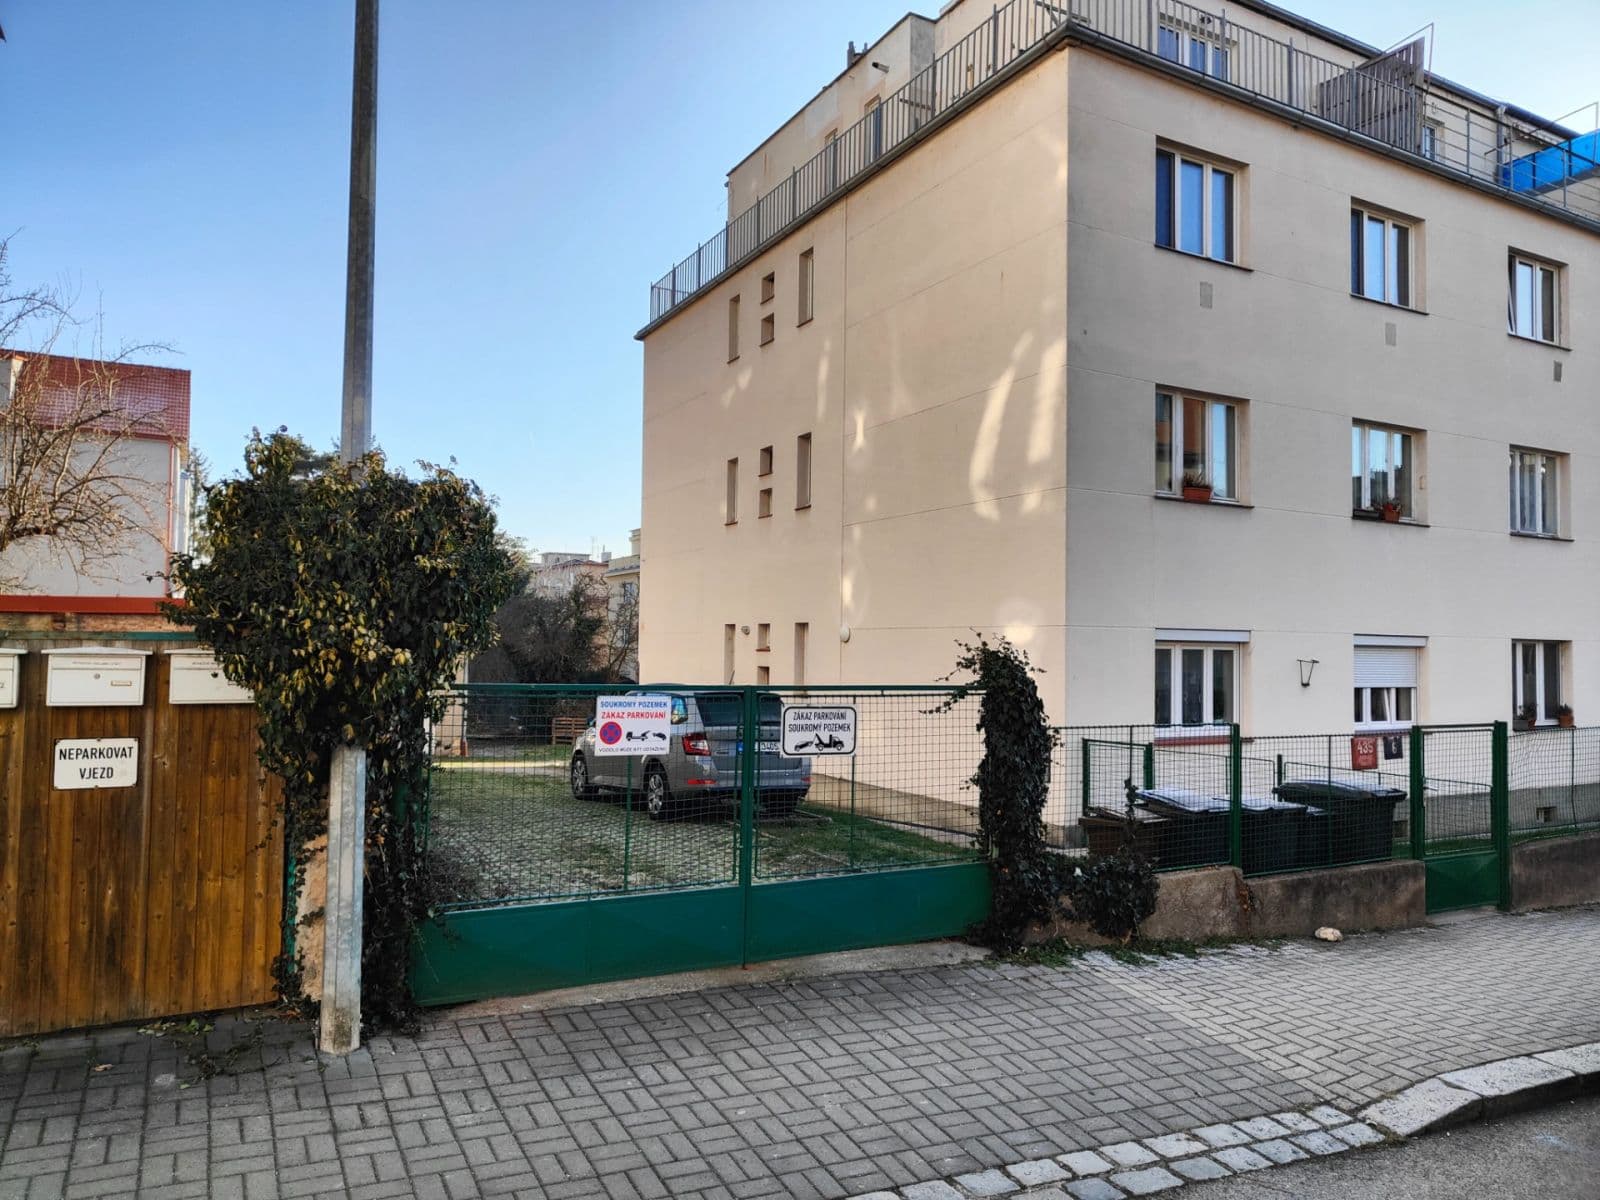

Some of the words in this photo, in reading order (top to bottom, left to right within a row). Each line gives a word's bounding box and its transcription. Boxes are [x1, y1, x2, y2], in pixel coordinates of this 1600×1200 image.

[824, 723, 851, 732] POZEMEK
[59, 746, 134, 760] NEPARKOVAT
[79, 767, 114, 780] VJEZD
